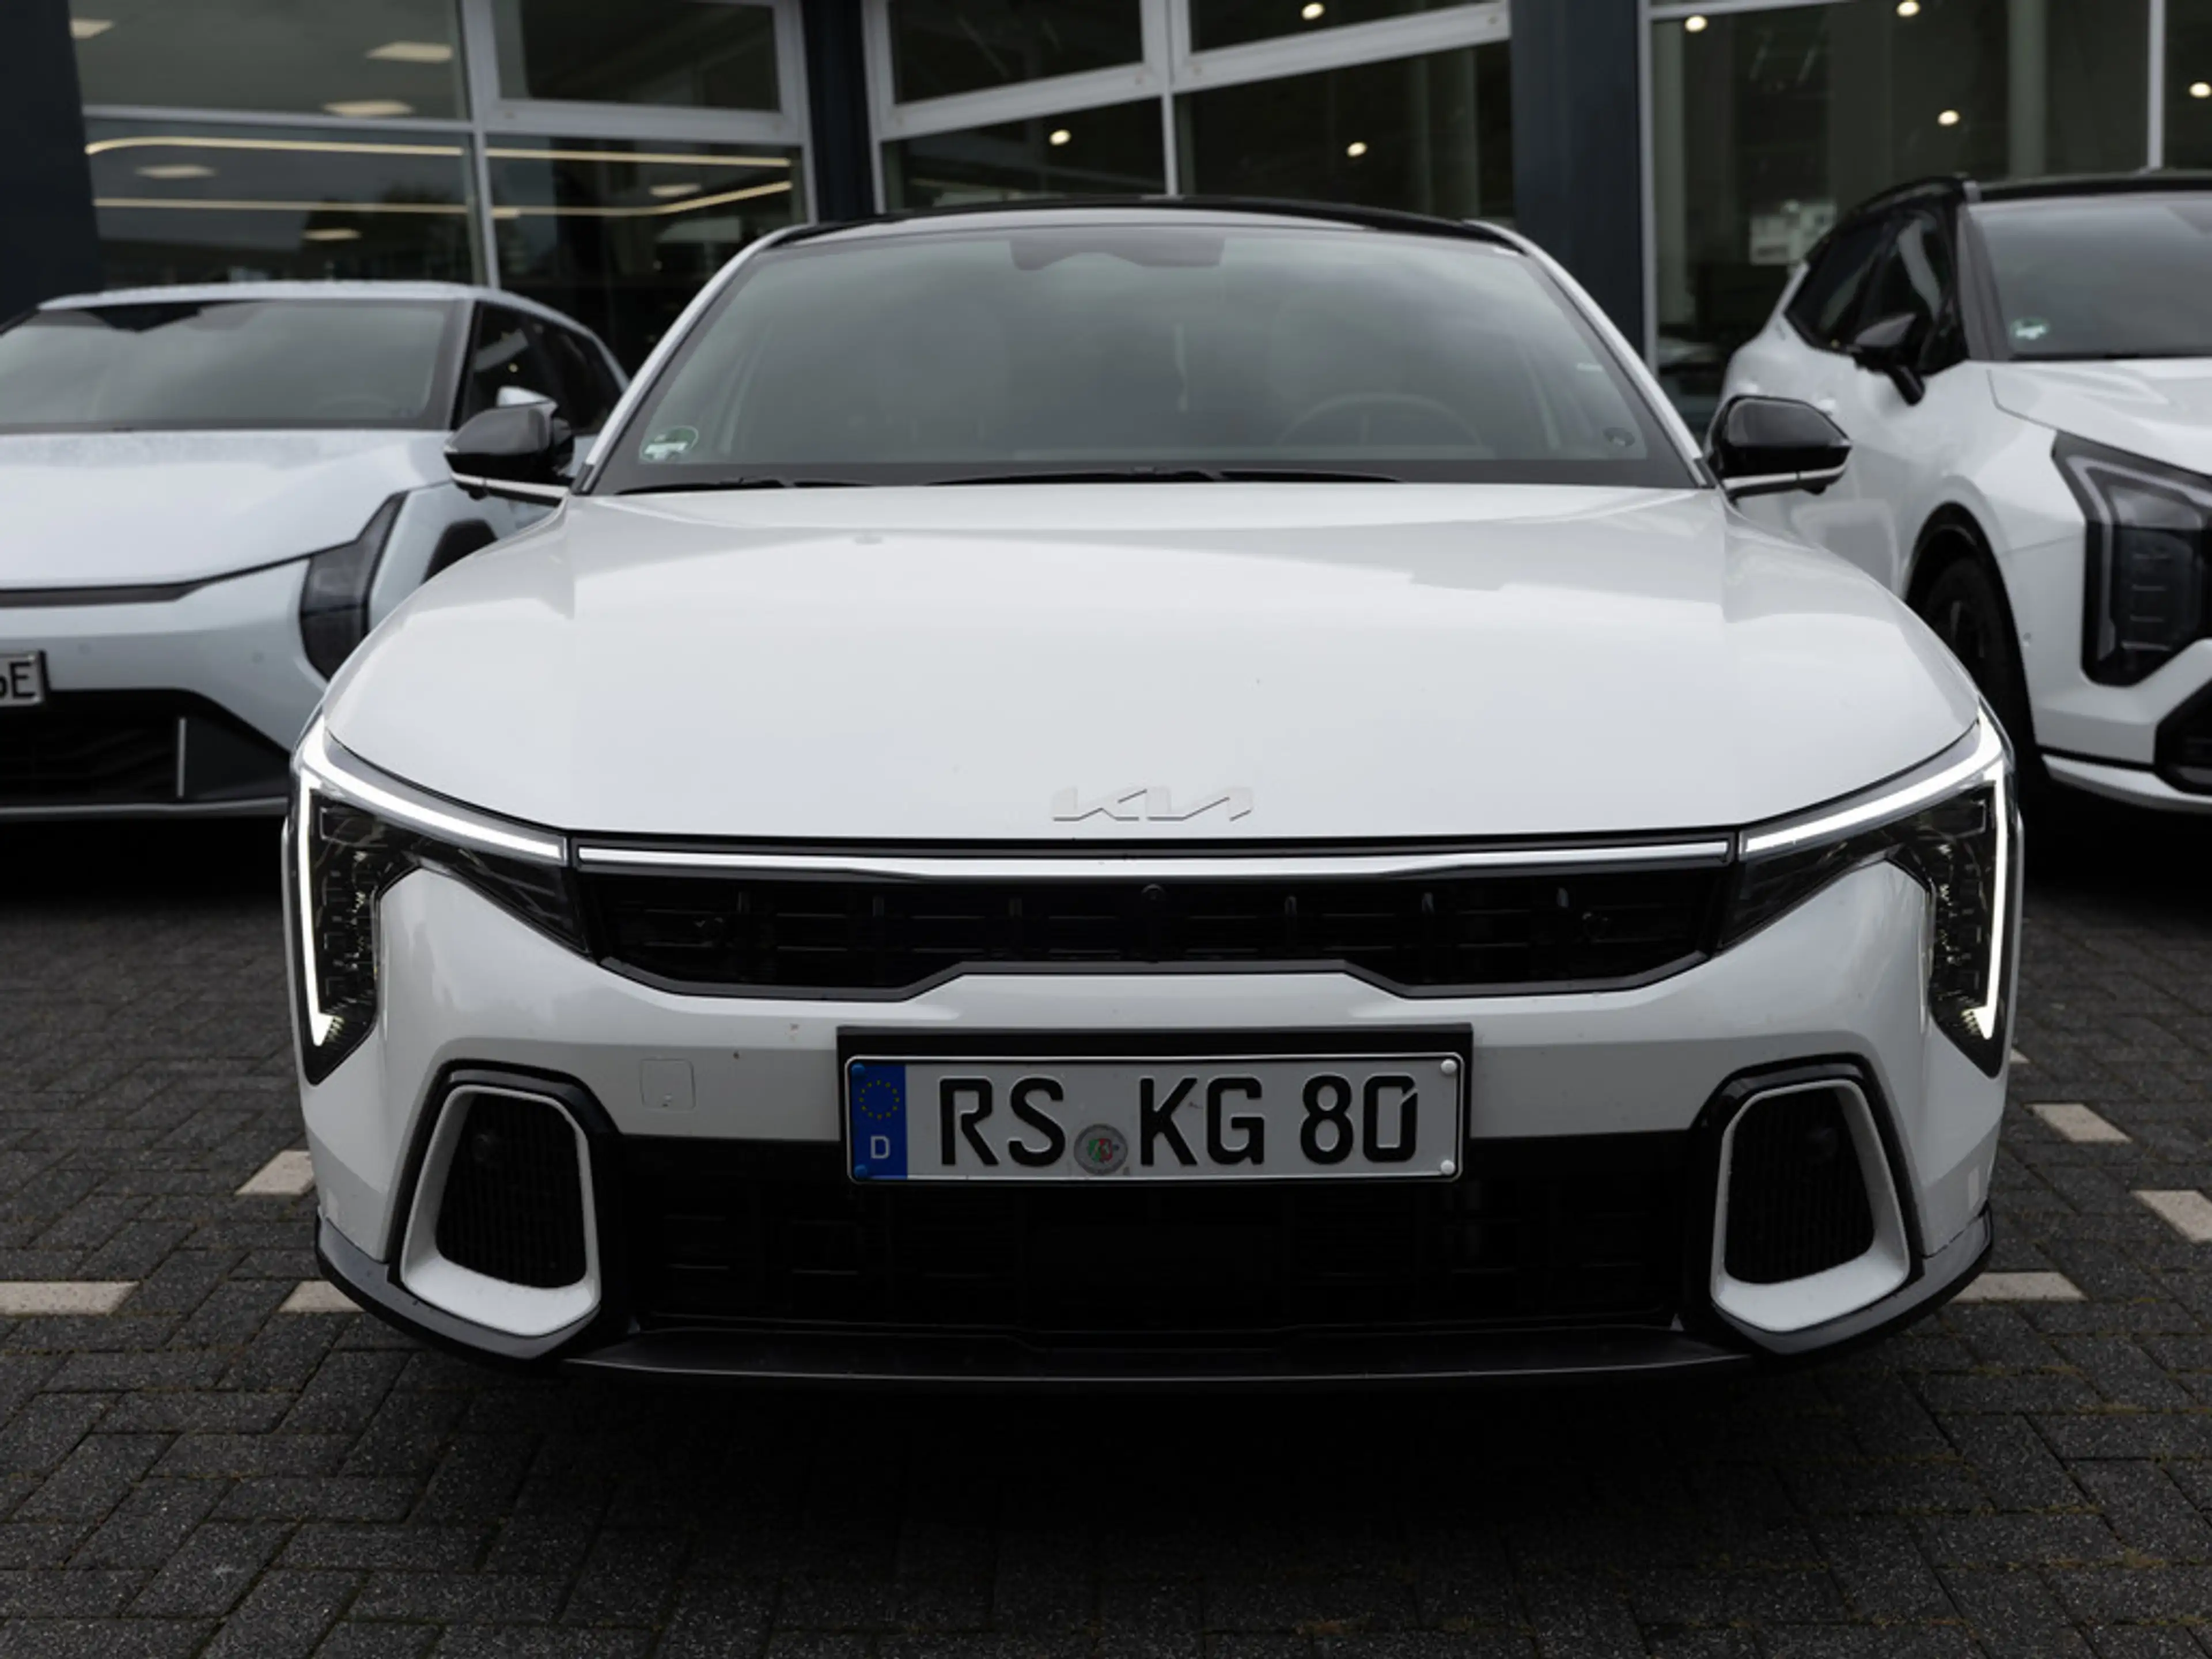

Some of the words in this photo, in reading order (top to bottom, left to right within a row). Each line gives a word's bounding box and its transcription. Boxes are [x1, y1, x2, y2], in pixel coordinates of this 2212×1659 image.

[1051, 786, 1253, 821] KIA
[939, 1077, 1066, 1168] RS
[1139, 1077, 1266, 1168] KG
[1300, 1075, 1419, 1166] 80
[870, 1135, 890, 1160] D
